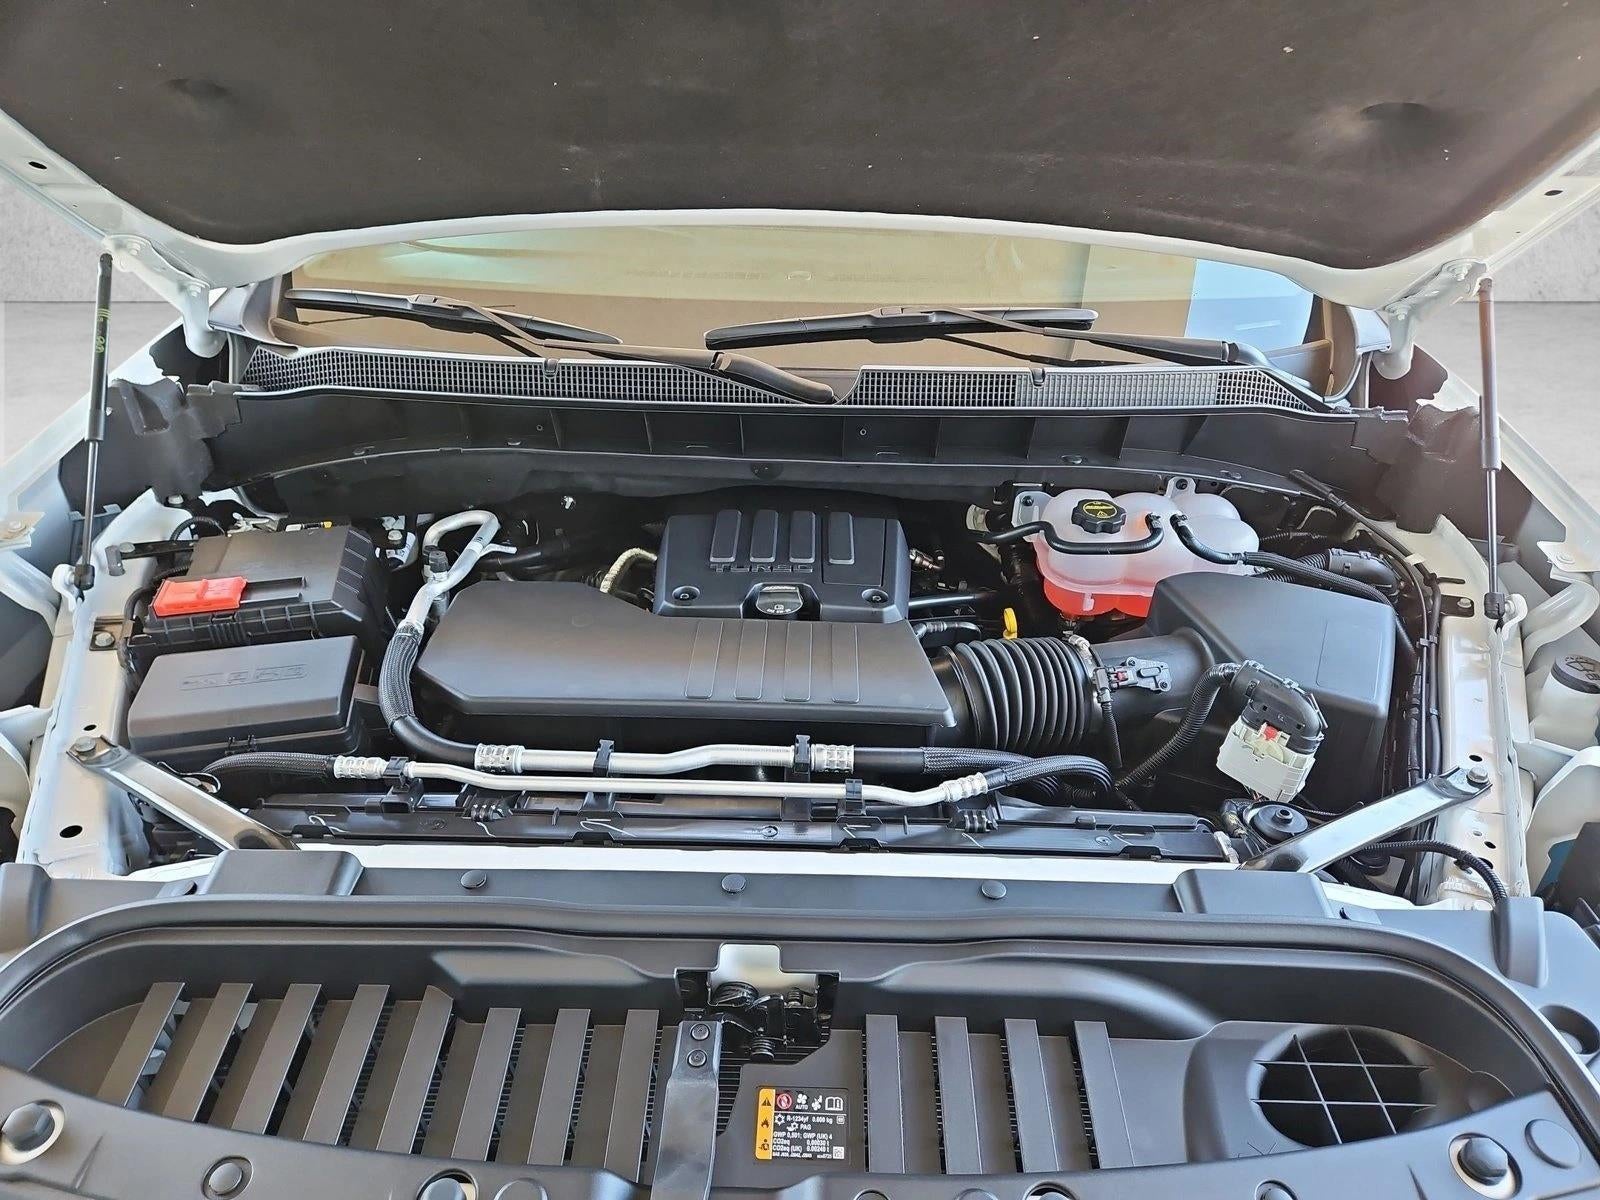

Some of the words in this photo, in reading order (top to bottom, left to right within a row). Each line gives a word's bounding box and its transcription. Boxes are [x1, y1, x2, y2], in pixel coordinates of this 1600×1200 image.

[786, 1115, 809, 1123] R-1234yf
[816, 1132, 829, 1140] (UK)
[790, 1145, 803, 1153] (UK)
